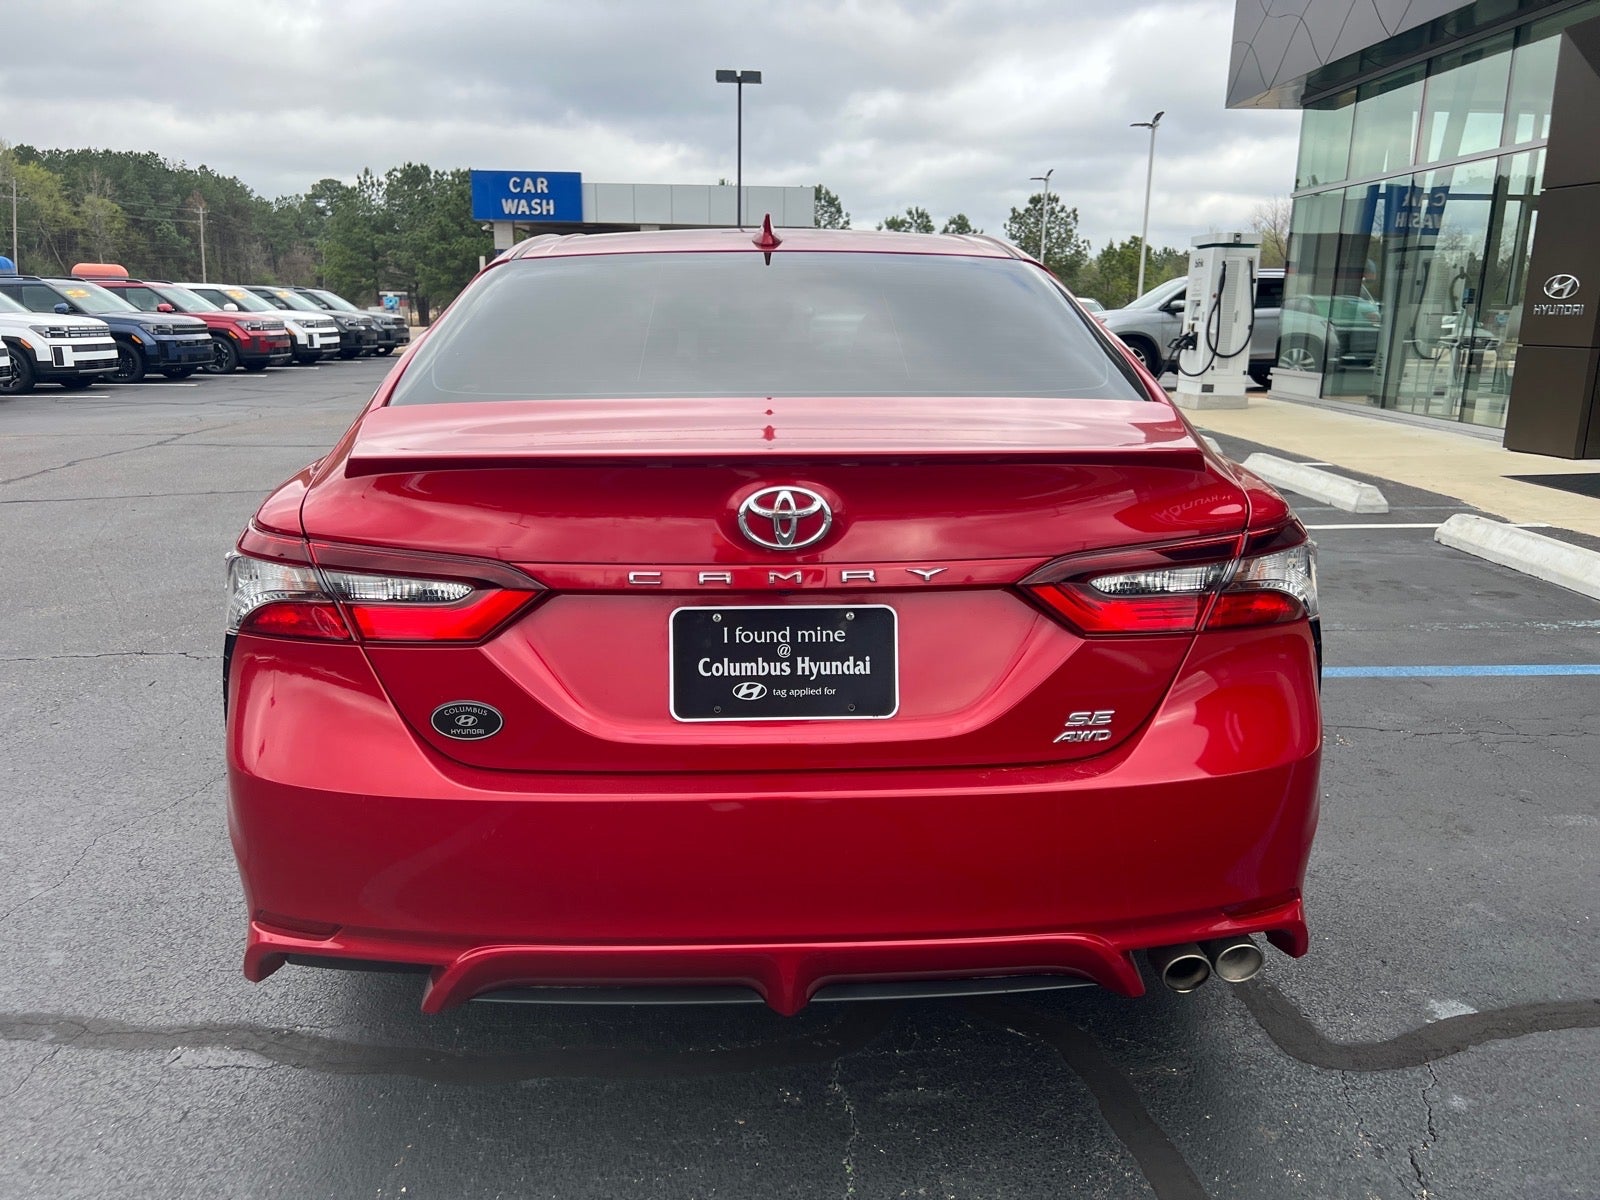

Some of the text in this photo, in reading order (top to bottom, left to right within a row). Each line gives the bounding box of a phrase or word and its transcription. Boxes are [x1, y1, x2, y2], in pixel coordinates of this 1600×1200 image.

[509, 177, 549, 194] CAR
[501, 198, 555, 215] WASH
[1533, 304, 1585, 316] HYUNDAI
[628, 567, 948, 585] CAMRY
[723, 626, 846, 643] I found mine
[777, 643, 791, 658] @
[698, 655, 871, 680] Columbus Hyundai
[773, 686, 837, 698] tag applied for
[444, 706, 488, 716] COLUMBUS
[1065, 710, 1116, 726] SE
[1053, 729, 1112, 743] AWD
